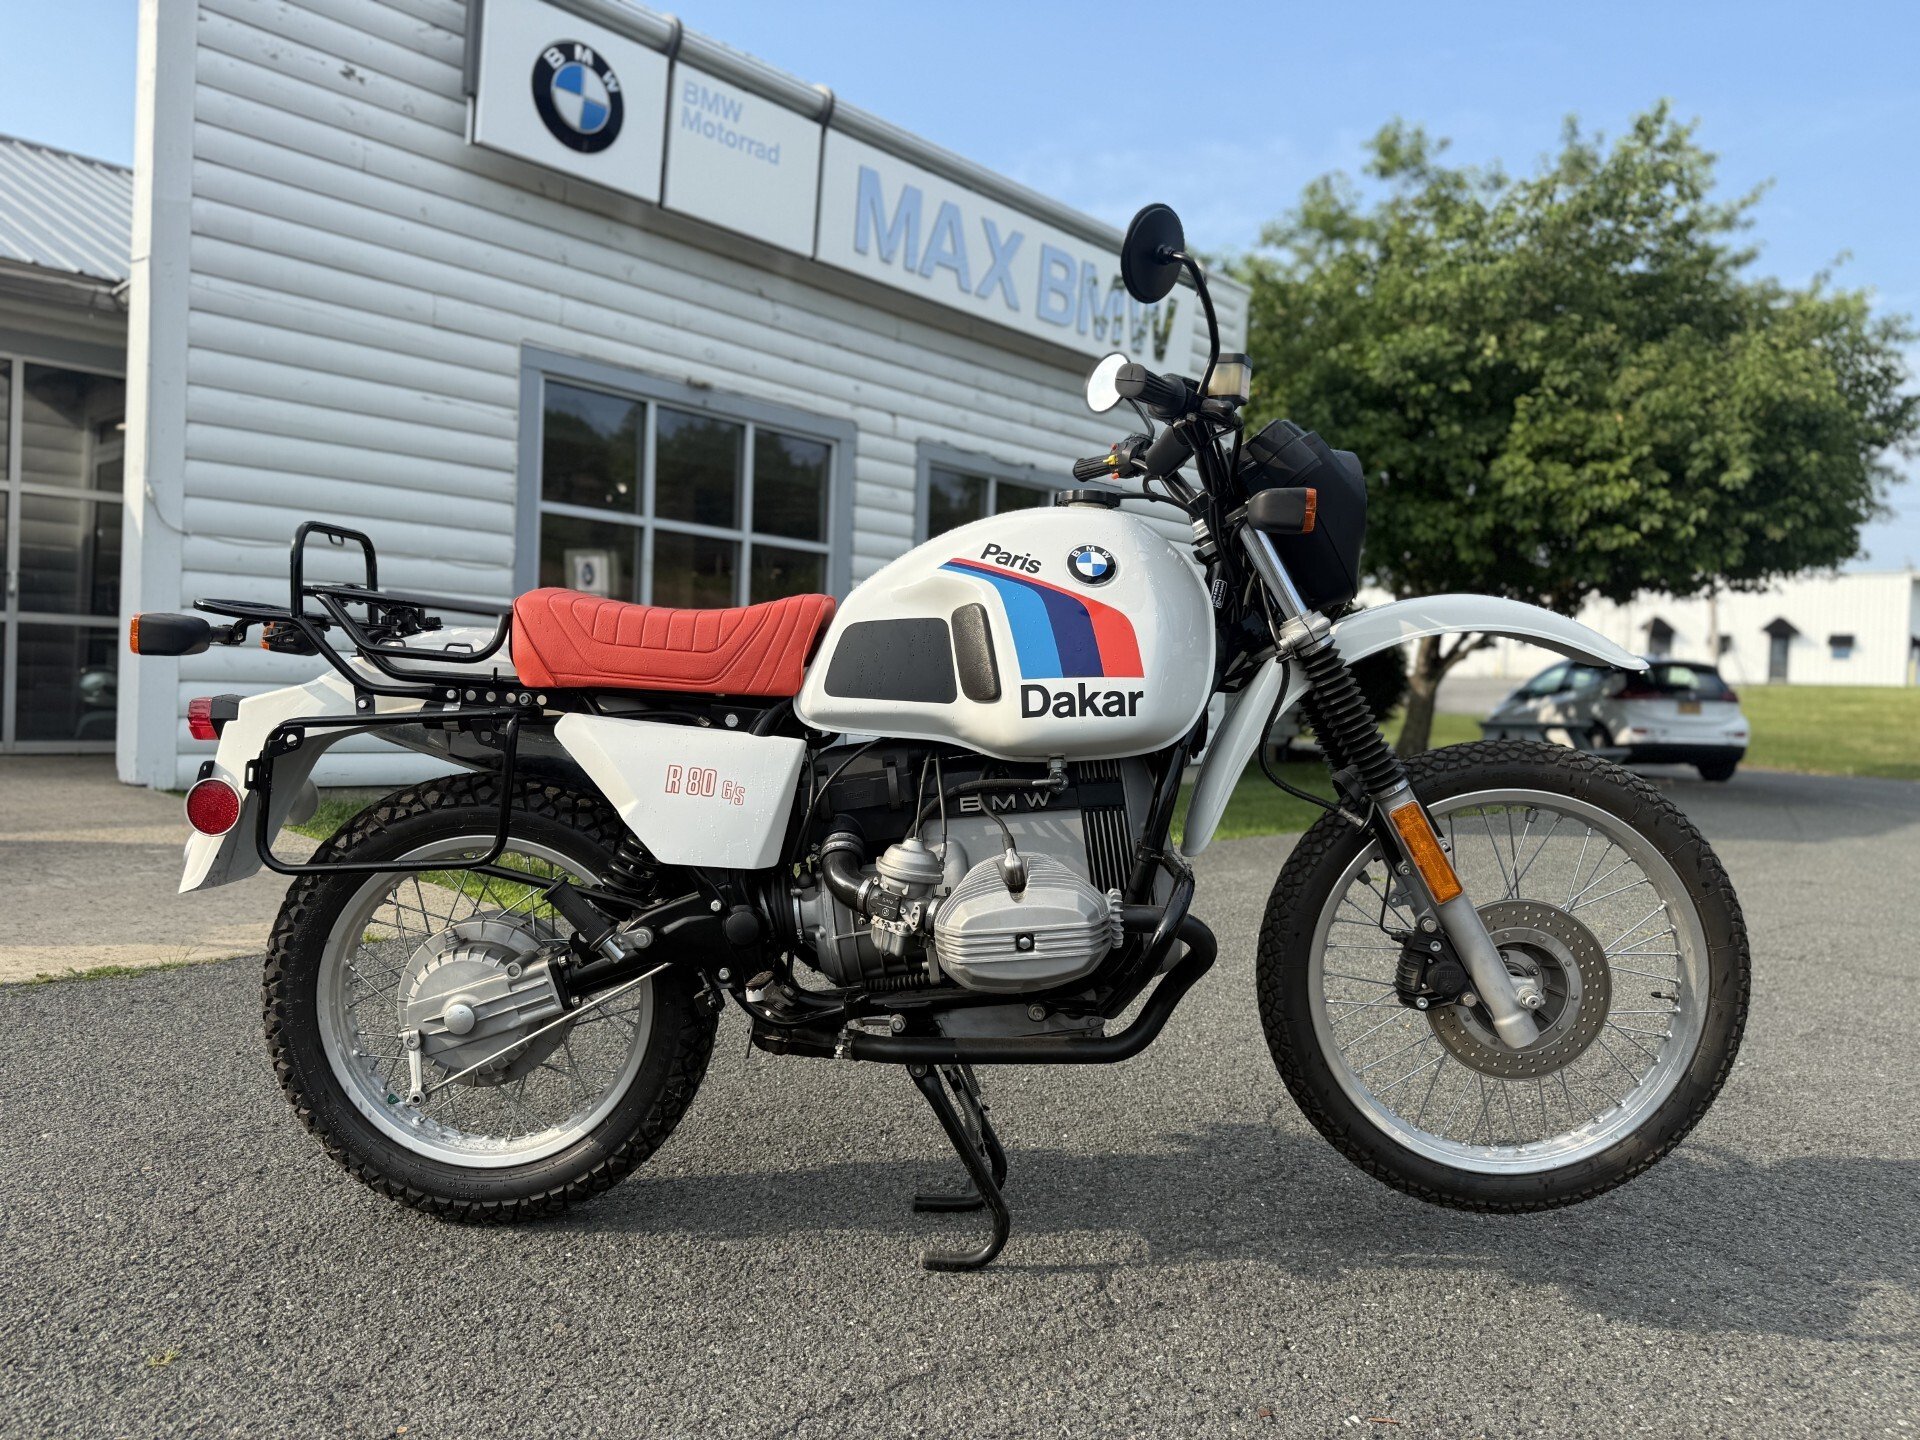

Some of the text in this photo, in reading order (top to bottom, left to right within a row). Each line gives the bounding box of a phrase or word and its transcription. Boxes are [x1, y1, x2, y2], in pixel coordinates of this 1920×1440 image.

[543, 44, 620, 94] BMW
[682, 80, 744, 123] BMW
[681, 106, 781, 165] Motorrad
[854, 164, 1178, 361] MAX BMW
[980, 543, 1042, 574] Paris
[1071, 545, 1112, 559] BMW
[1021, 682, 1144, 718] Dakar
[665, 764, 683, 794] R
[686, 767, 717, 797] 80
[960, 791, 1051, 812] BMW
